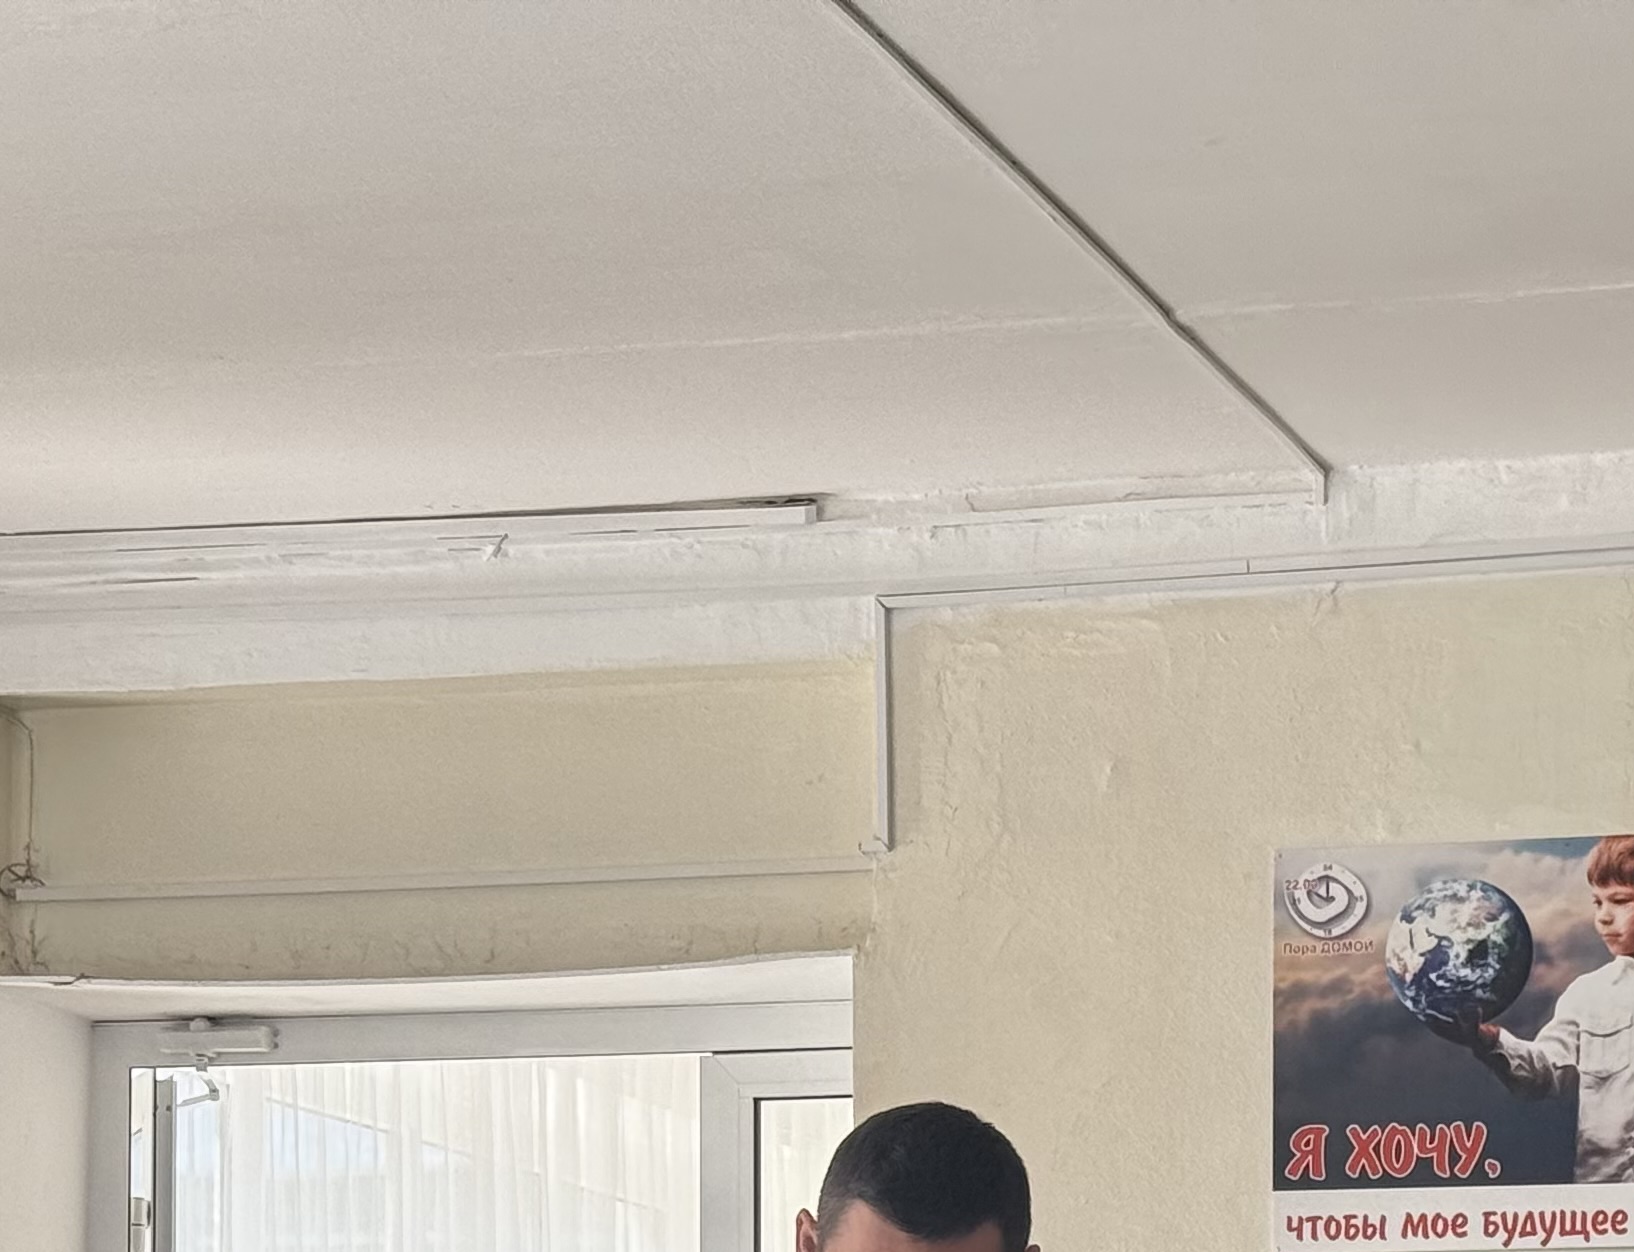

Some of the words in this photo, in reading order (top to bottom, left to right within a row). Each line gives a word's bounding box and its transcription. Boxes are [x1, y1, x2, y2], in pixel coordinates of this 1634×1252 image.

[1283, 941, 1317, 956] Пора
[1285, 1124, 1329, 1181] Я
[1346, 1120, 1501, 1180] ХОЧУ,
[1286, 1214, 1387, 1241] чтобы
[1401, 1212, 1468, 1239] мое
[1482, 1208, 1629, 1247] будущее
